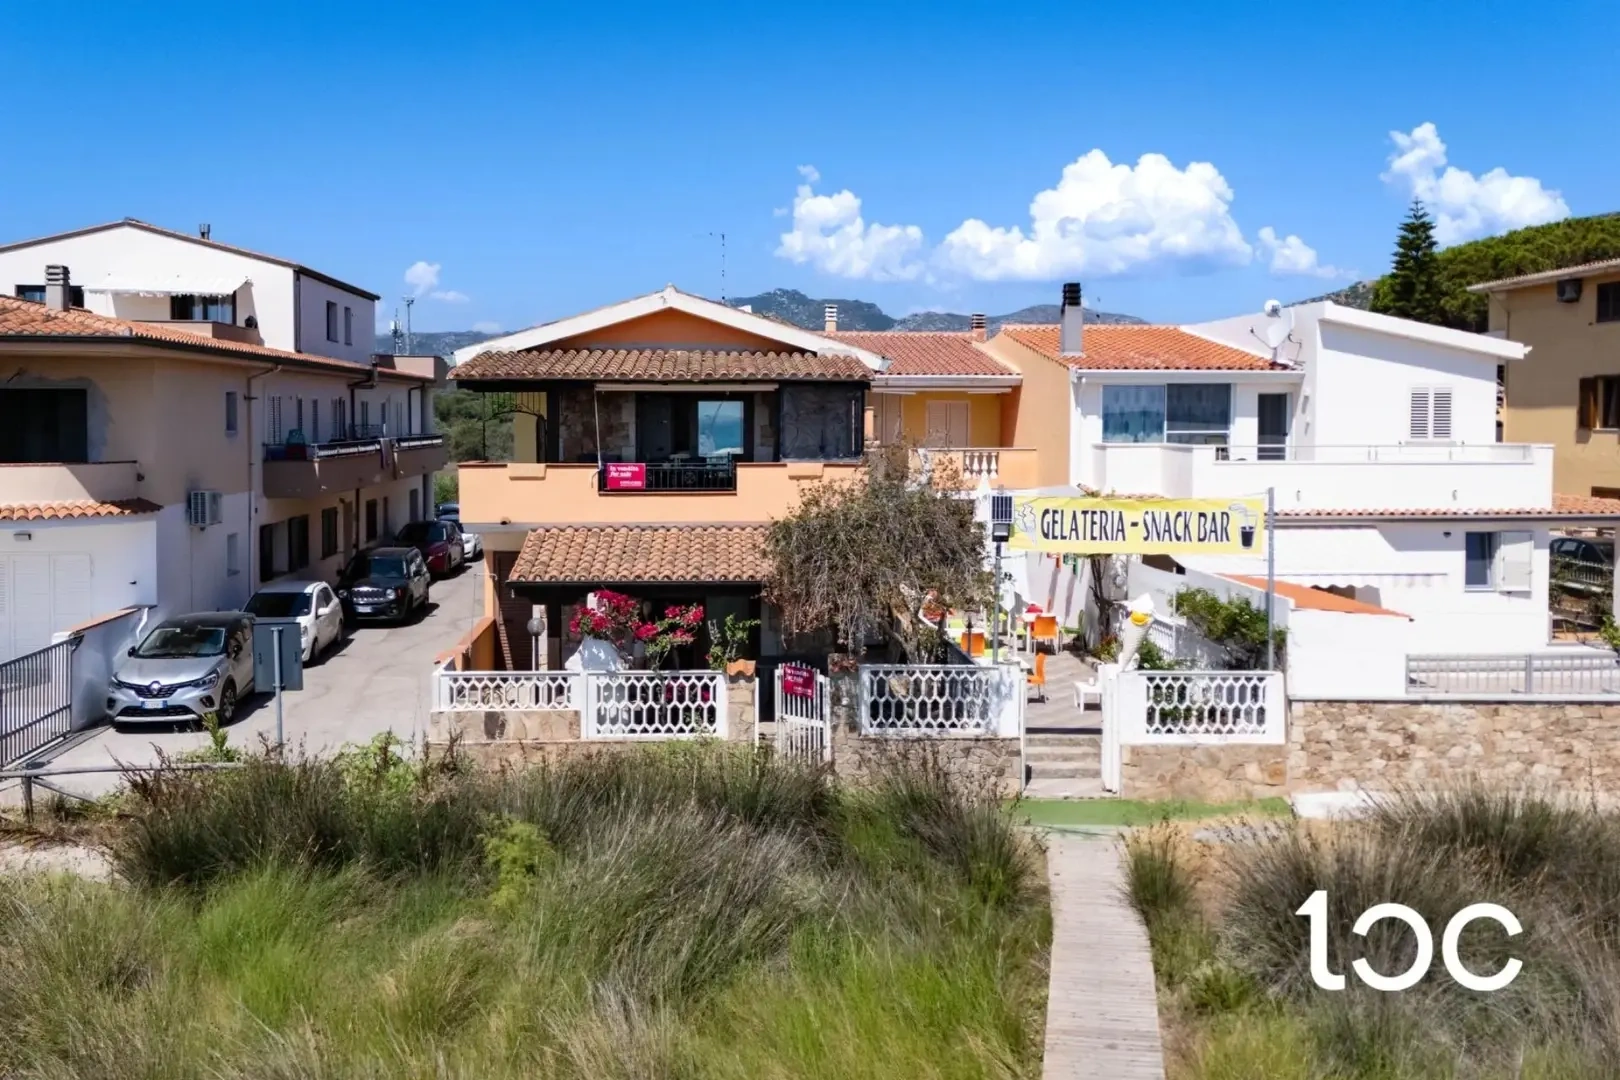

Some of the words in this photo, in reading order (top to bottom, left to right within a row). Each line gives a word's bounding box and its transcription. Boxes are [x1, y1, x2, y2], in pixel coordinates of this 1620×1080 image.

[1040, 508, 1126, 541] GELATERIA
[1143, 510, 1192, 542] SNACK
[1197, 512, 1230, 542] BAR
